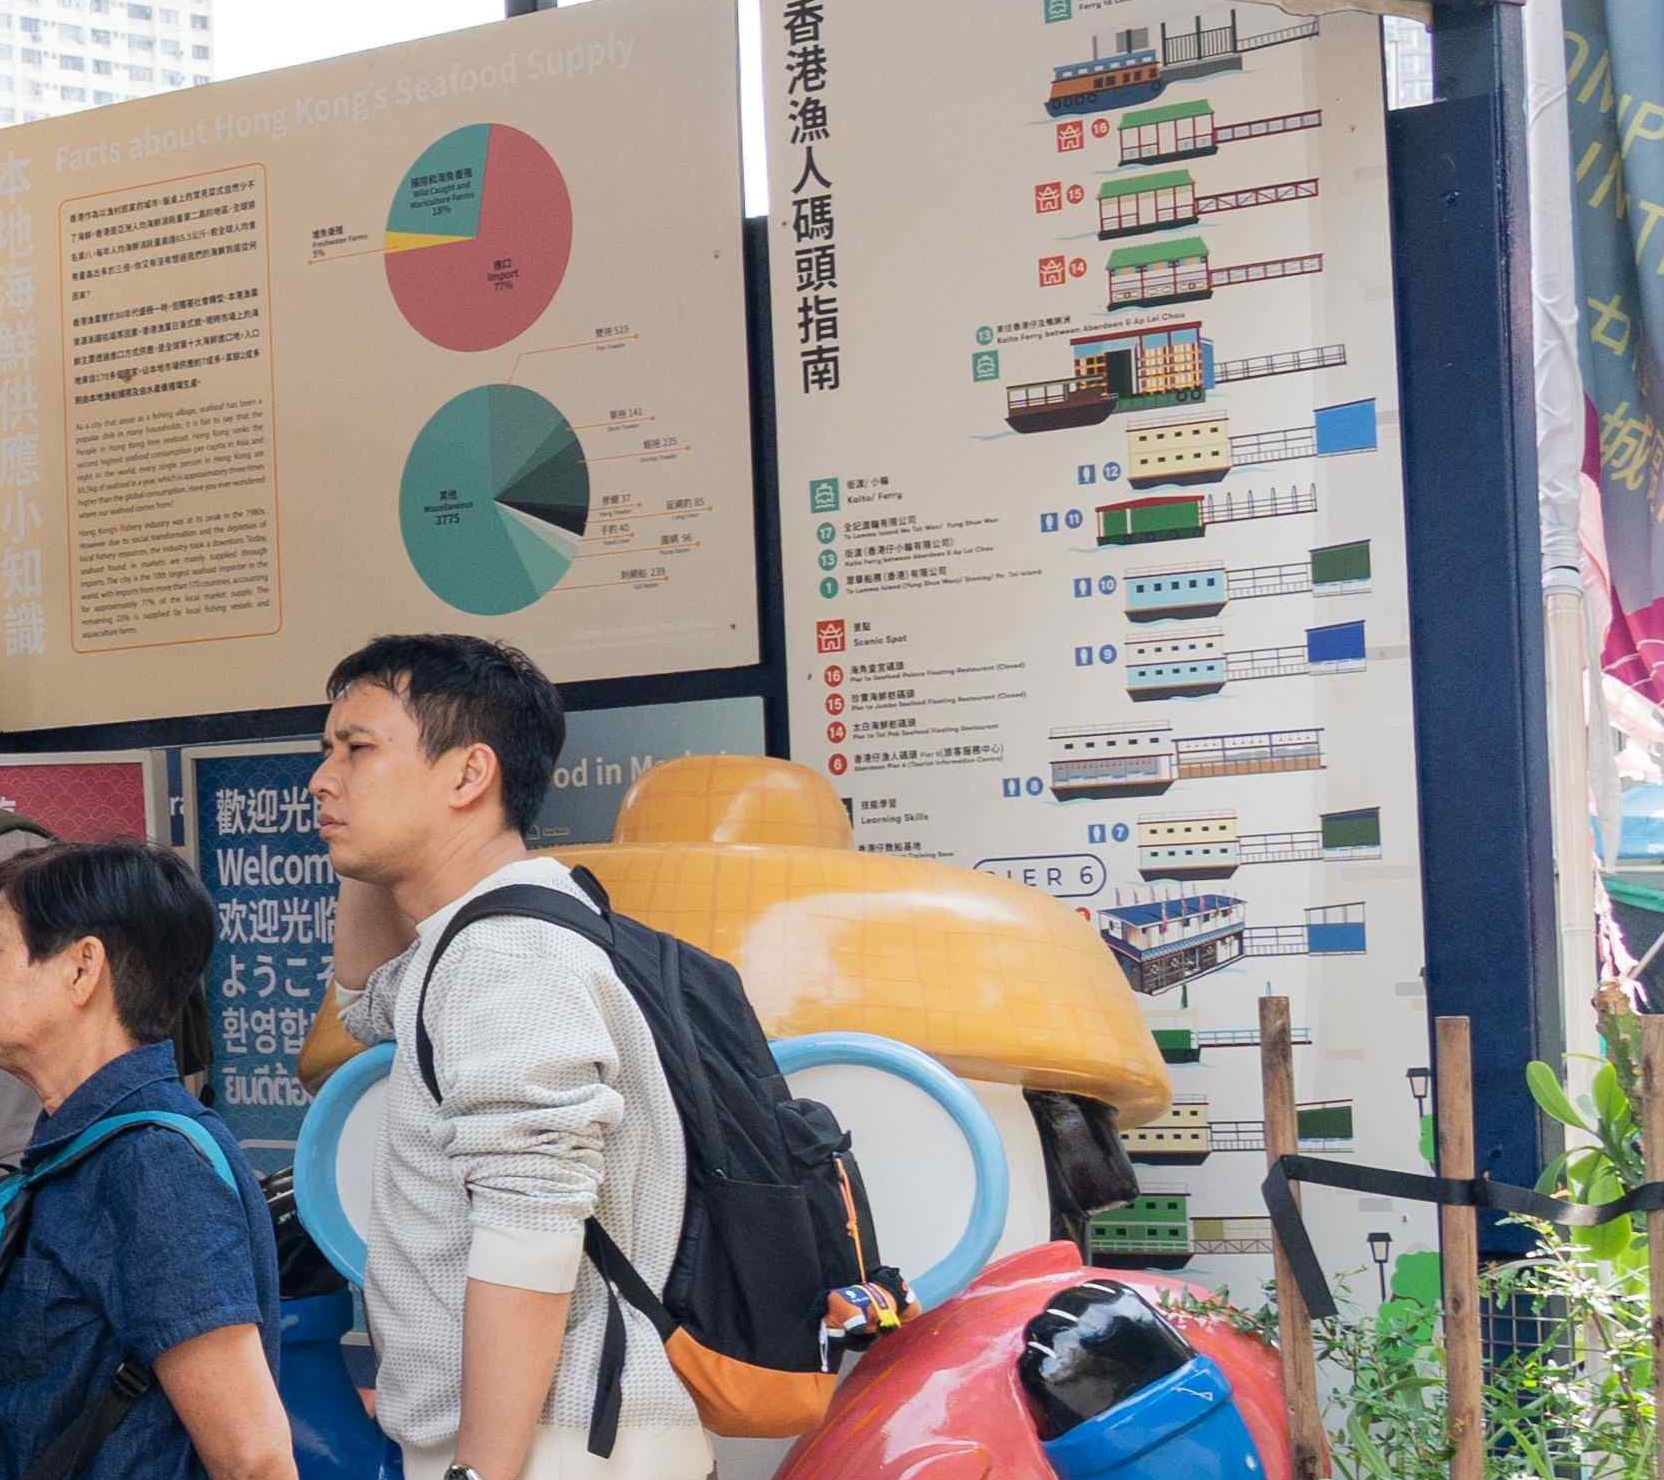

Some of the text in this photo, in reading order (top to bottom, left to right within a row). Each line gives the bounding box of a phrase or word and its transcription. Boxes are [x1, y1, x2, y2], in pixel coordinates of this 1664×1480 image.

[55, 144, 121, 173] Facts
[127, 123, 209, 160] about
[215, 103, 288, 139] Hong
[396, 51, 518, 106] Seafood
[525, 34, 635, 79] Supply
[878, 490, 903, 503] Ferry
[435, 513, 461, 526] 3775
[853, 634, 908, 648] Scenic Spot
[597, 757, 622, 785] in
[861, 812, 929, 825] Learning Skills
[217, 844, 342, 886] Welcom
[1079, 865, 1094, 885] 6
[222, 1007, 317, 1054] 환영합
